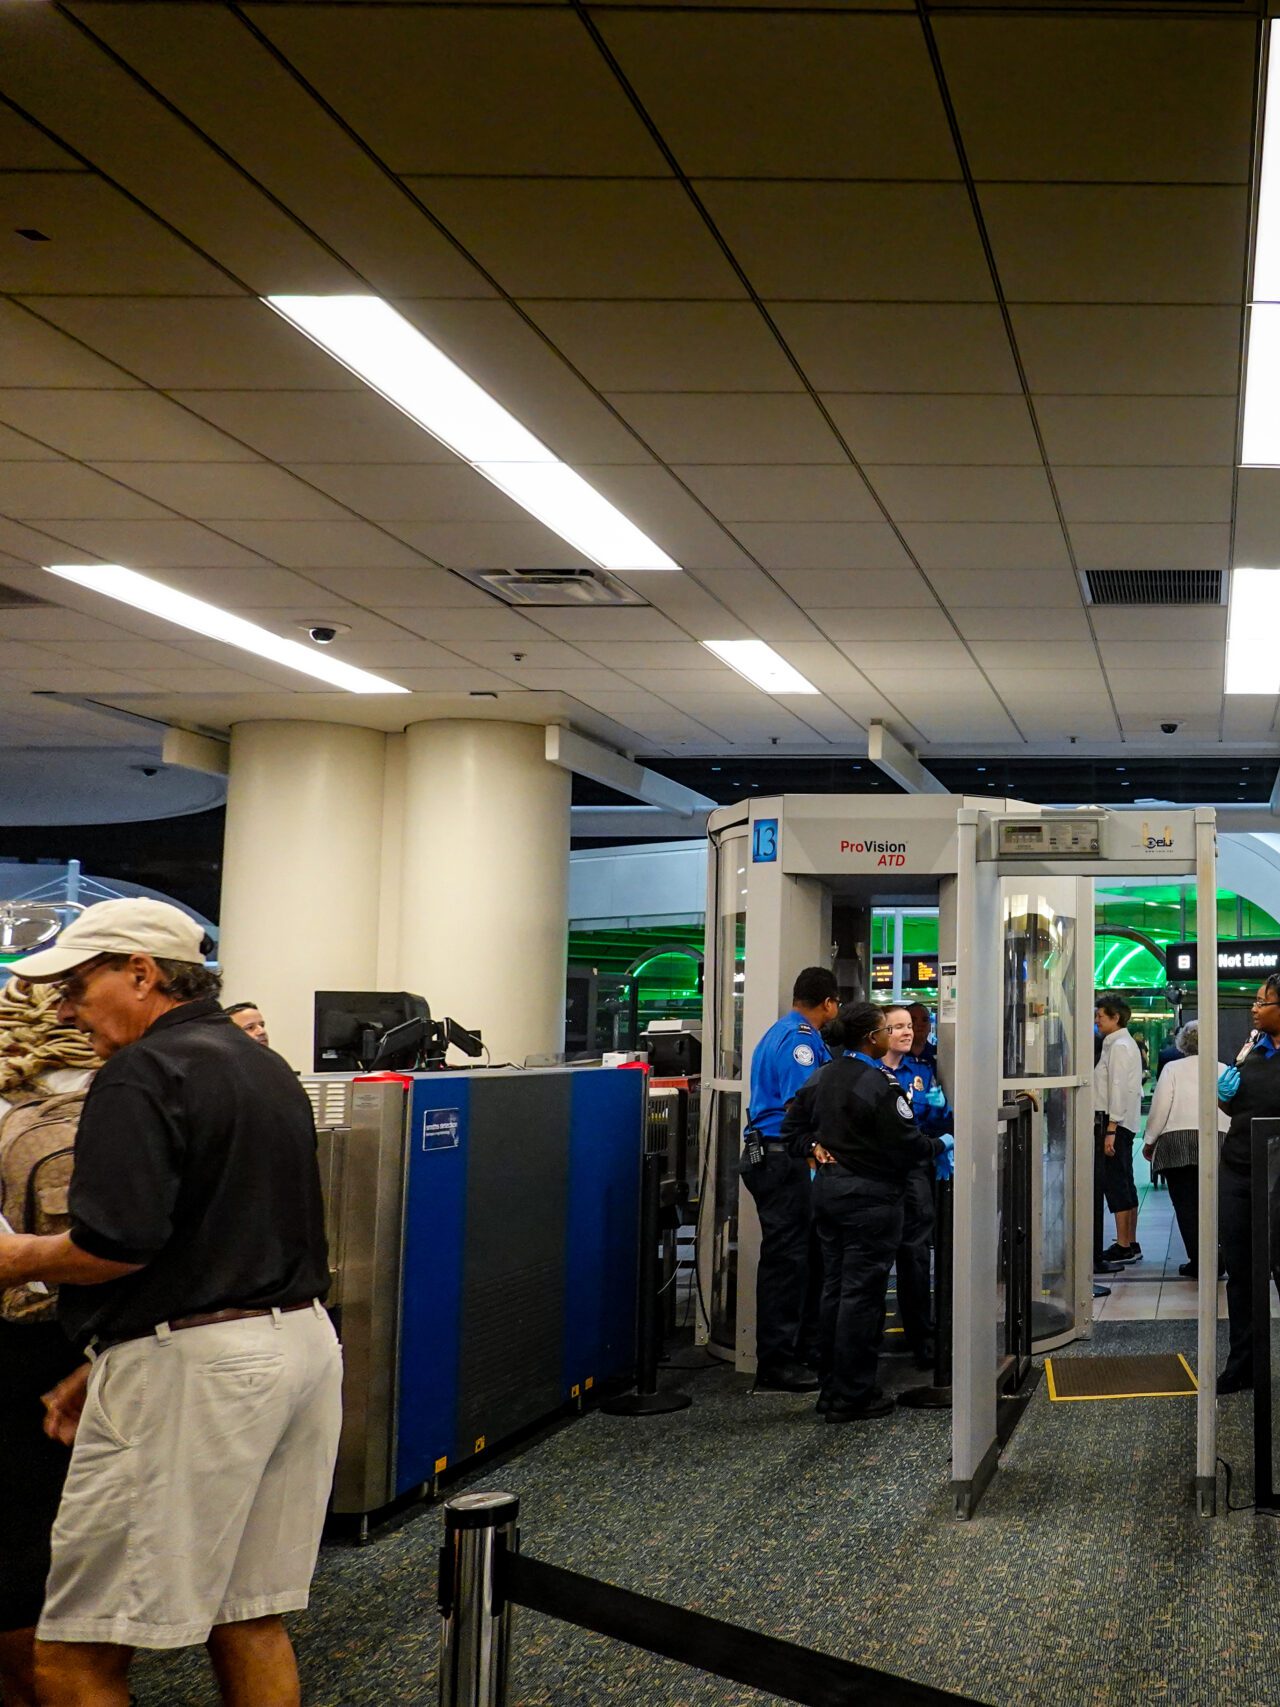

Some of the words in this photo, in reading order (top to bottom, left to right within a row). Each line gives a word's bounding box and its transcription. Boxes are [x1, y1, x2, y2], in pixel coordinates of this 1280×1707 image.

[754, 827, 776, 857] 13
[840, 840, 906, 853] ProVision
[877, 854, 906, 867] ATD
[1218, 953, 1242, 968] Not
[1243, 952, 1278, 967] Enter
